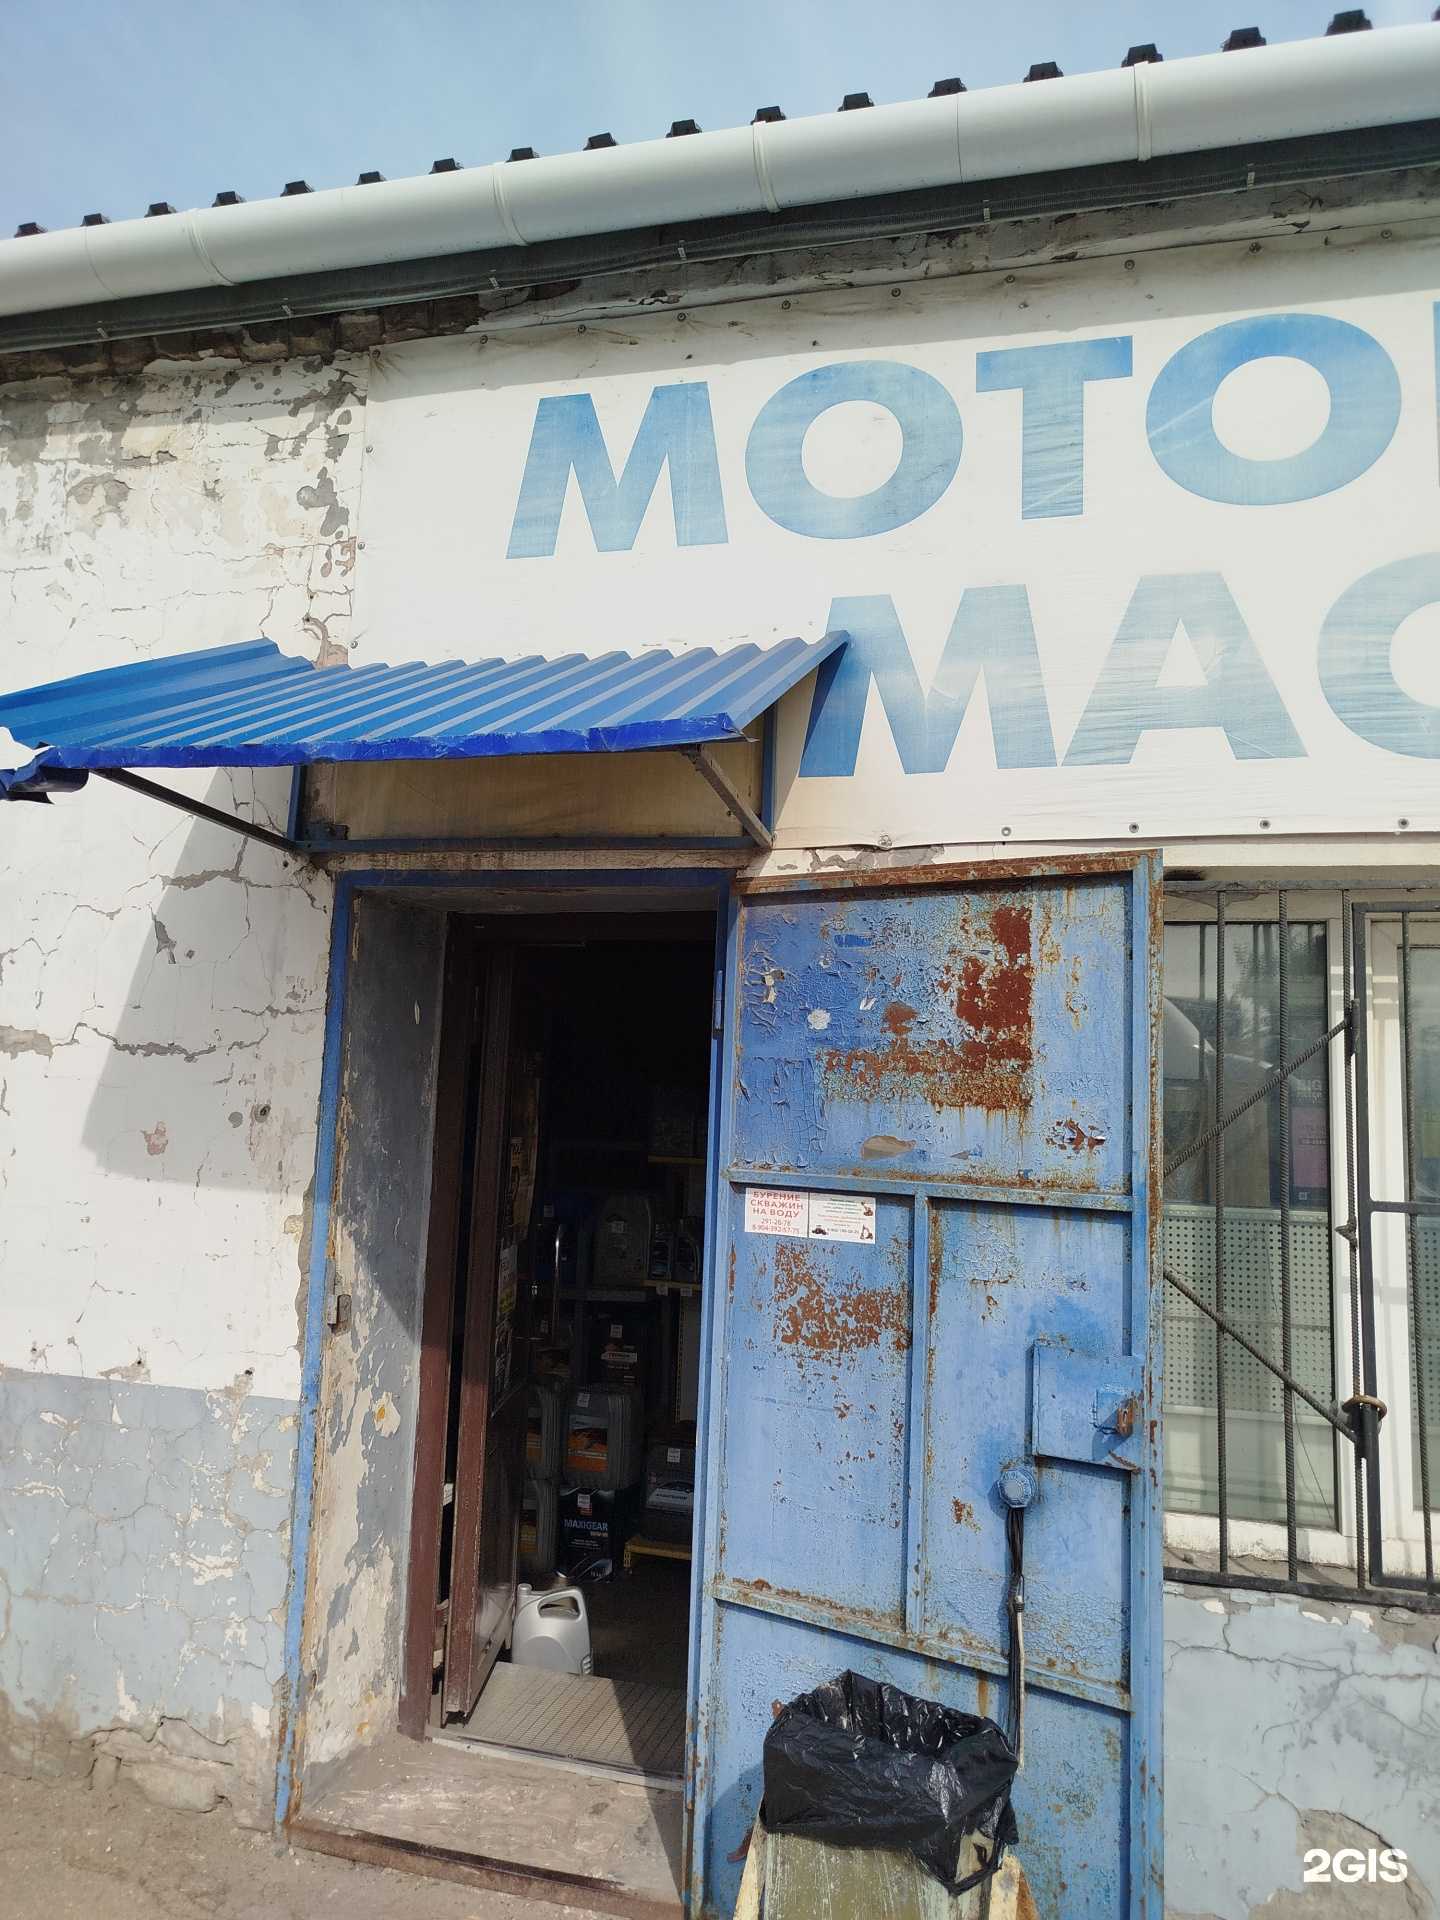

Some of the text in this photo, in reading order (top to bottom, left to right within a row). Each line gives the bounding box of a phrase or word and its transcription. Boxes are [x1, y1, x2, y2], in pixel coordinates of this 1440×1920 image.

[506, 301, 1440, 560] МОТО
[753, 1191, 801, 1201] БУРЕНИЕ
[750, 1199, 804, 1210] СКВАЖИН
[770, 1209, 800, 1218] ВОДУ
